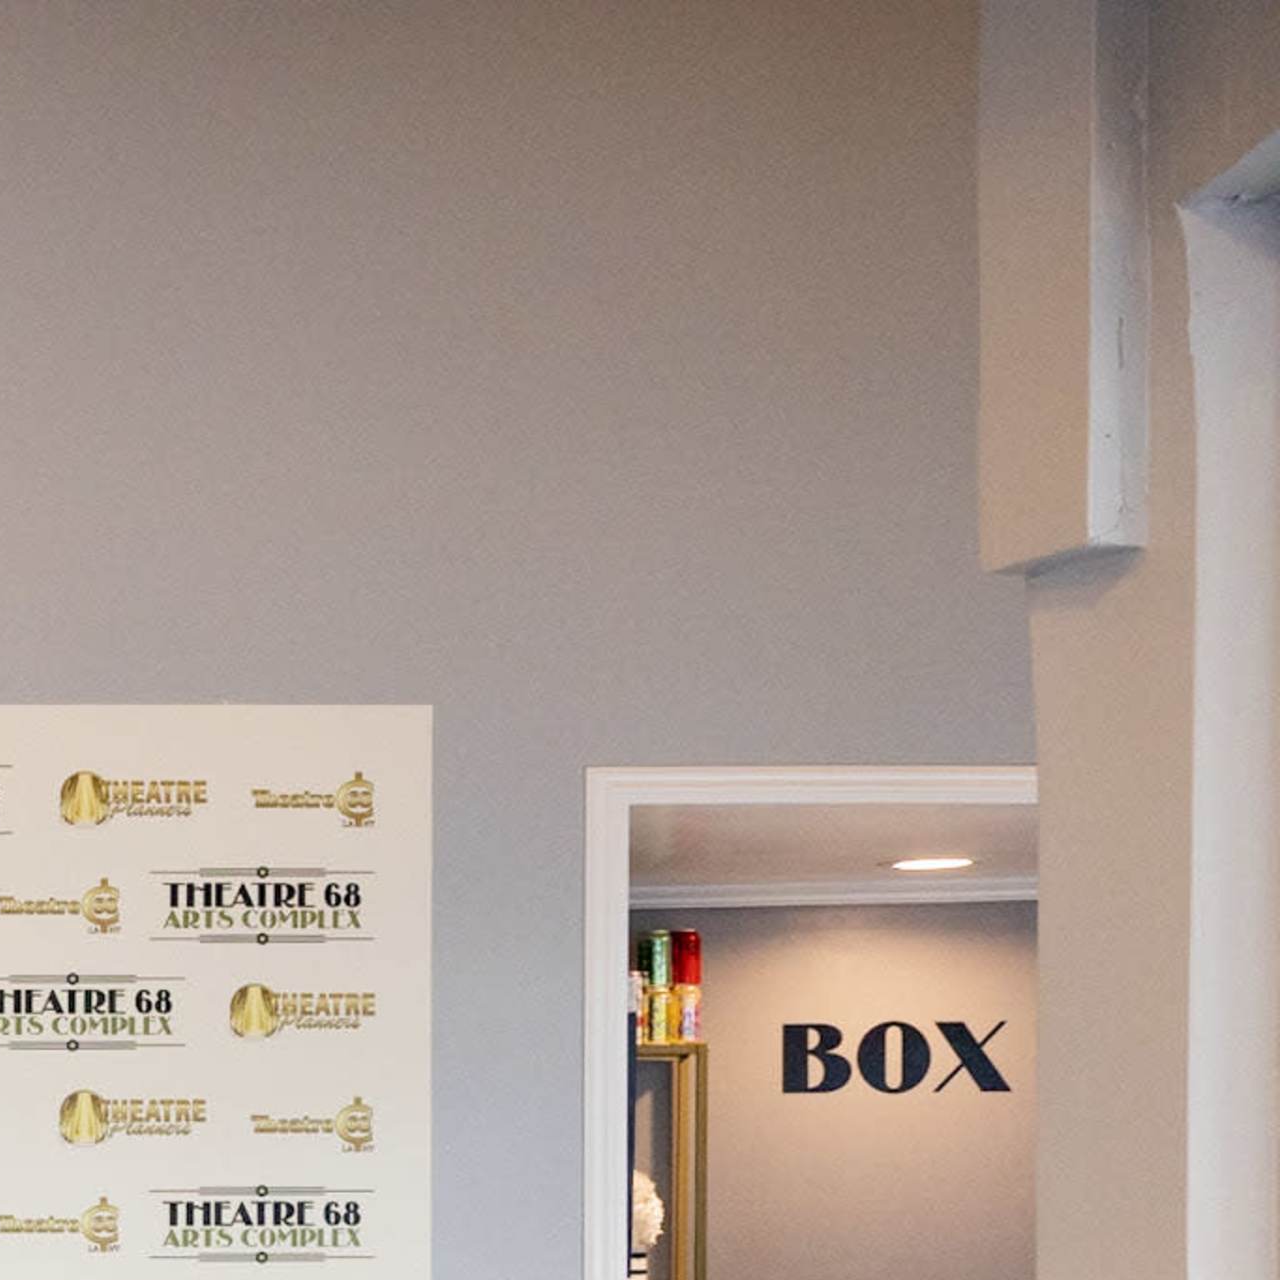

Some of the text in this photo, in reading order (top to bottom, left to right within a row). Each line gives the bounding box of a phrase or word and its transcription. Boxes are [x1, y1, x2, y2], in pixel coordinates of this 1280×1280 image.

[101, 780, 207, 805] THEATRE
[162, 882, 363, 909] THEATRE 68
[162, 910, 363, 929] ARTS COMPLEX
[135, 988, 173, 1014] 68
[270, 992, 376, 1017] THEATRE
[51, 1016, 173, 1035] COMPLEX
[782, 1020, 1011, 1094] BOX
[101, 1098, 207, 1123] THEATRE
[161, 1200, 362, 1227] THEATRE 68
[161, 1228, 362, 1247] ARTS COMPLEX
